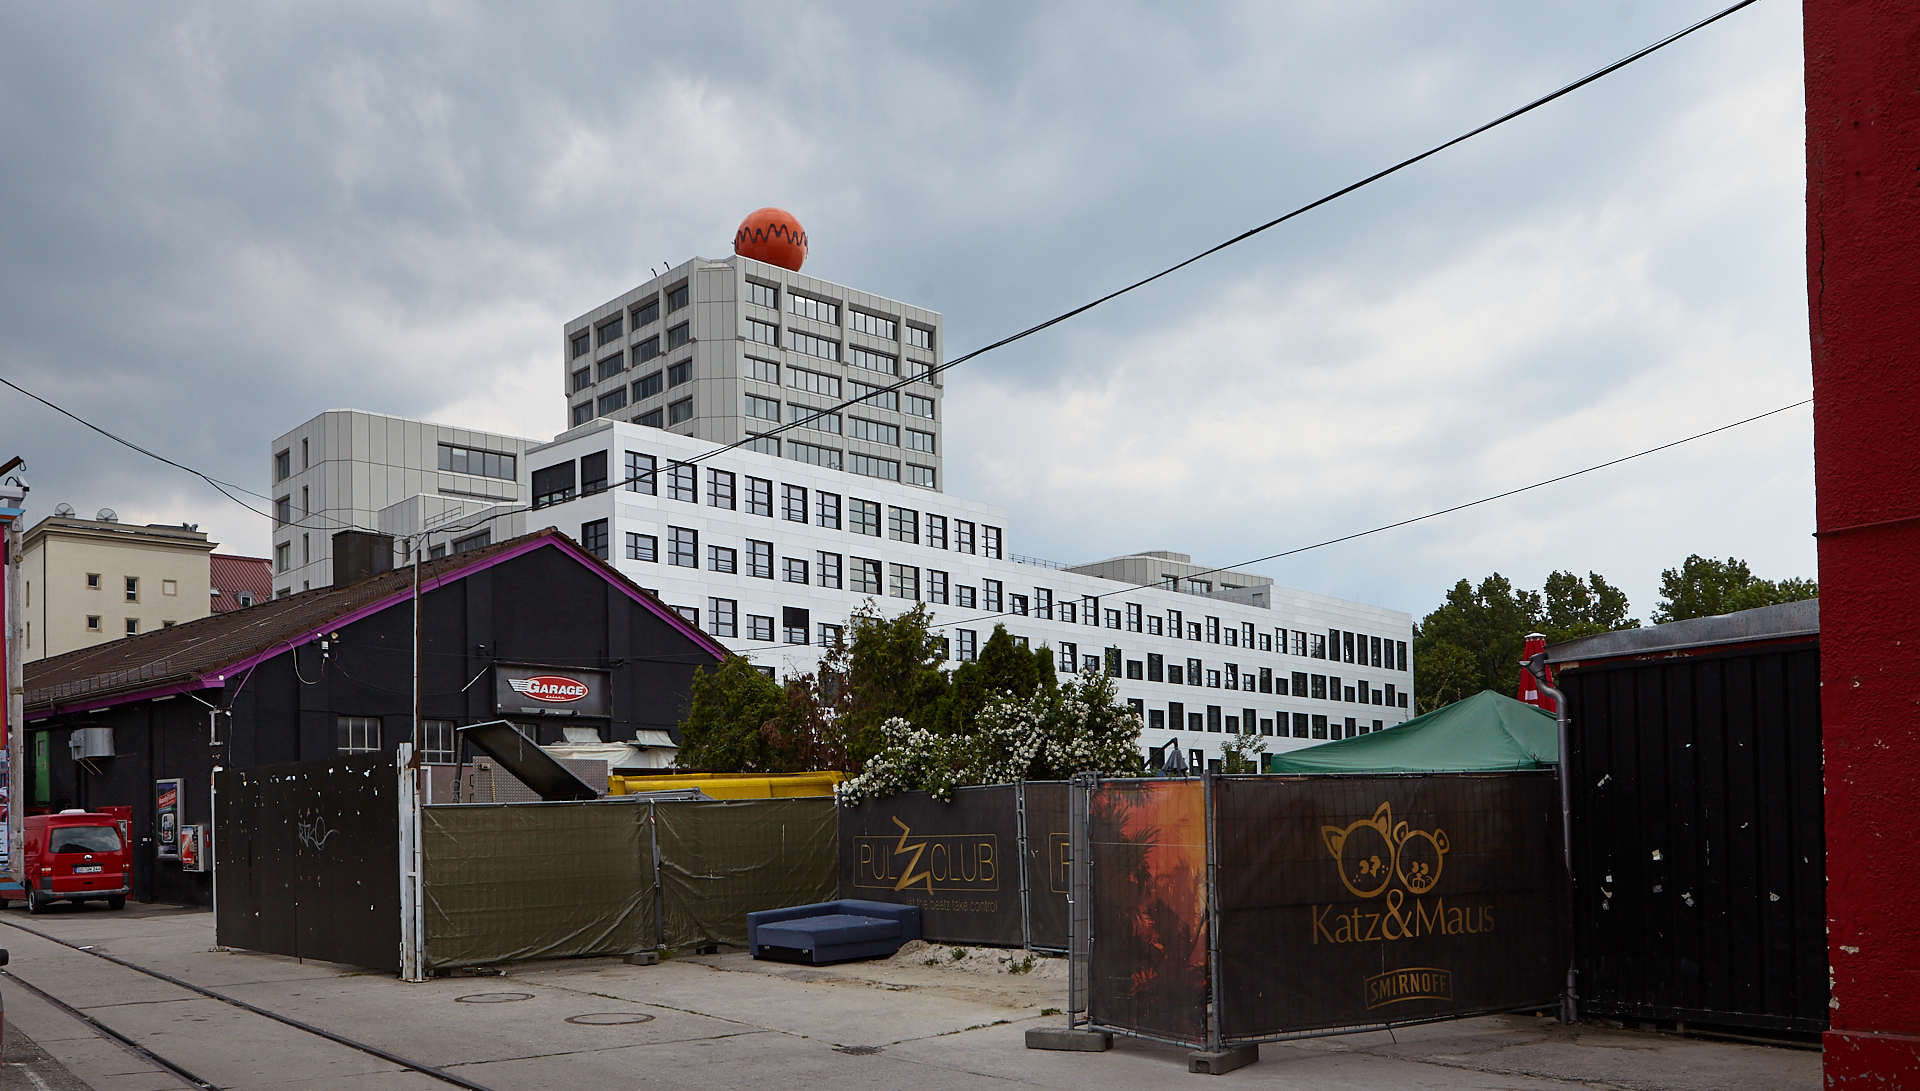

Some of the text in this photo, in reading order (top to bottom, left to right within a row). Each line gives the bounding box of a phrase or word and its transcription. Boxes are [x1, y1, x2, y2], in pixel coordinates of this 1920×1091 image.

[526, 680, 584, 696] GARAGE
[930, 898, 951, 911] beatz
[951, 898, 968, 912] take
[970, 899, 998, 913] control
[1311, 888, 1495, 945] Katz&Maus
[1370, 972, 1447, 1002] SMIRNOFF
